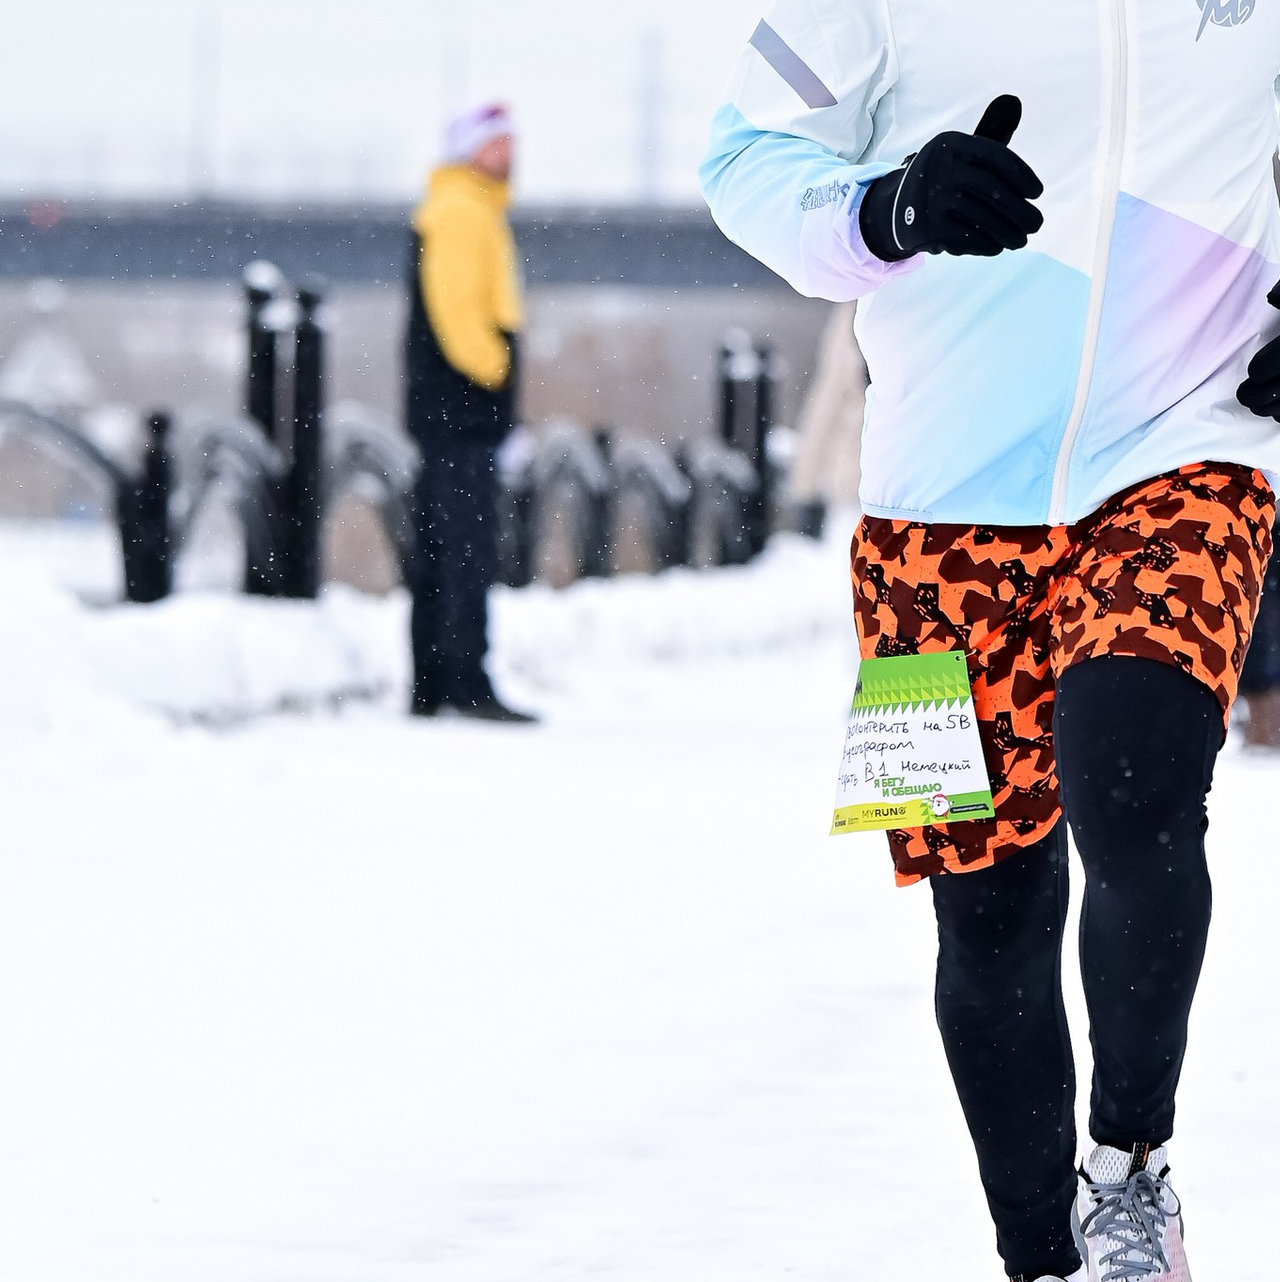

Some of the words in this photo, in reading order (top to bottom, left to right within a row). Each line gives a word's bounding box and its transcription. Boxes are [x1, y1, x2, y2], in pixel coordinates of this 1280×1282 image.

[923, 721, 943, 732] на
[874, 779, 880, 788] Я
[881, 777, 905, 788] БЕГУ
[882, 788, 889, 797] И
[891, 783, 942, 796] ОБЕЩАЮ
